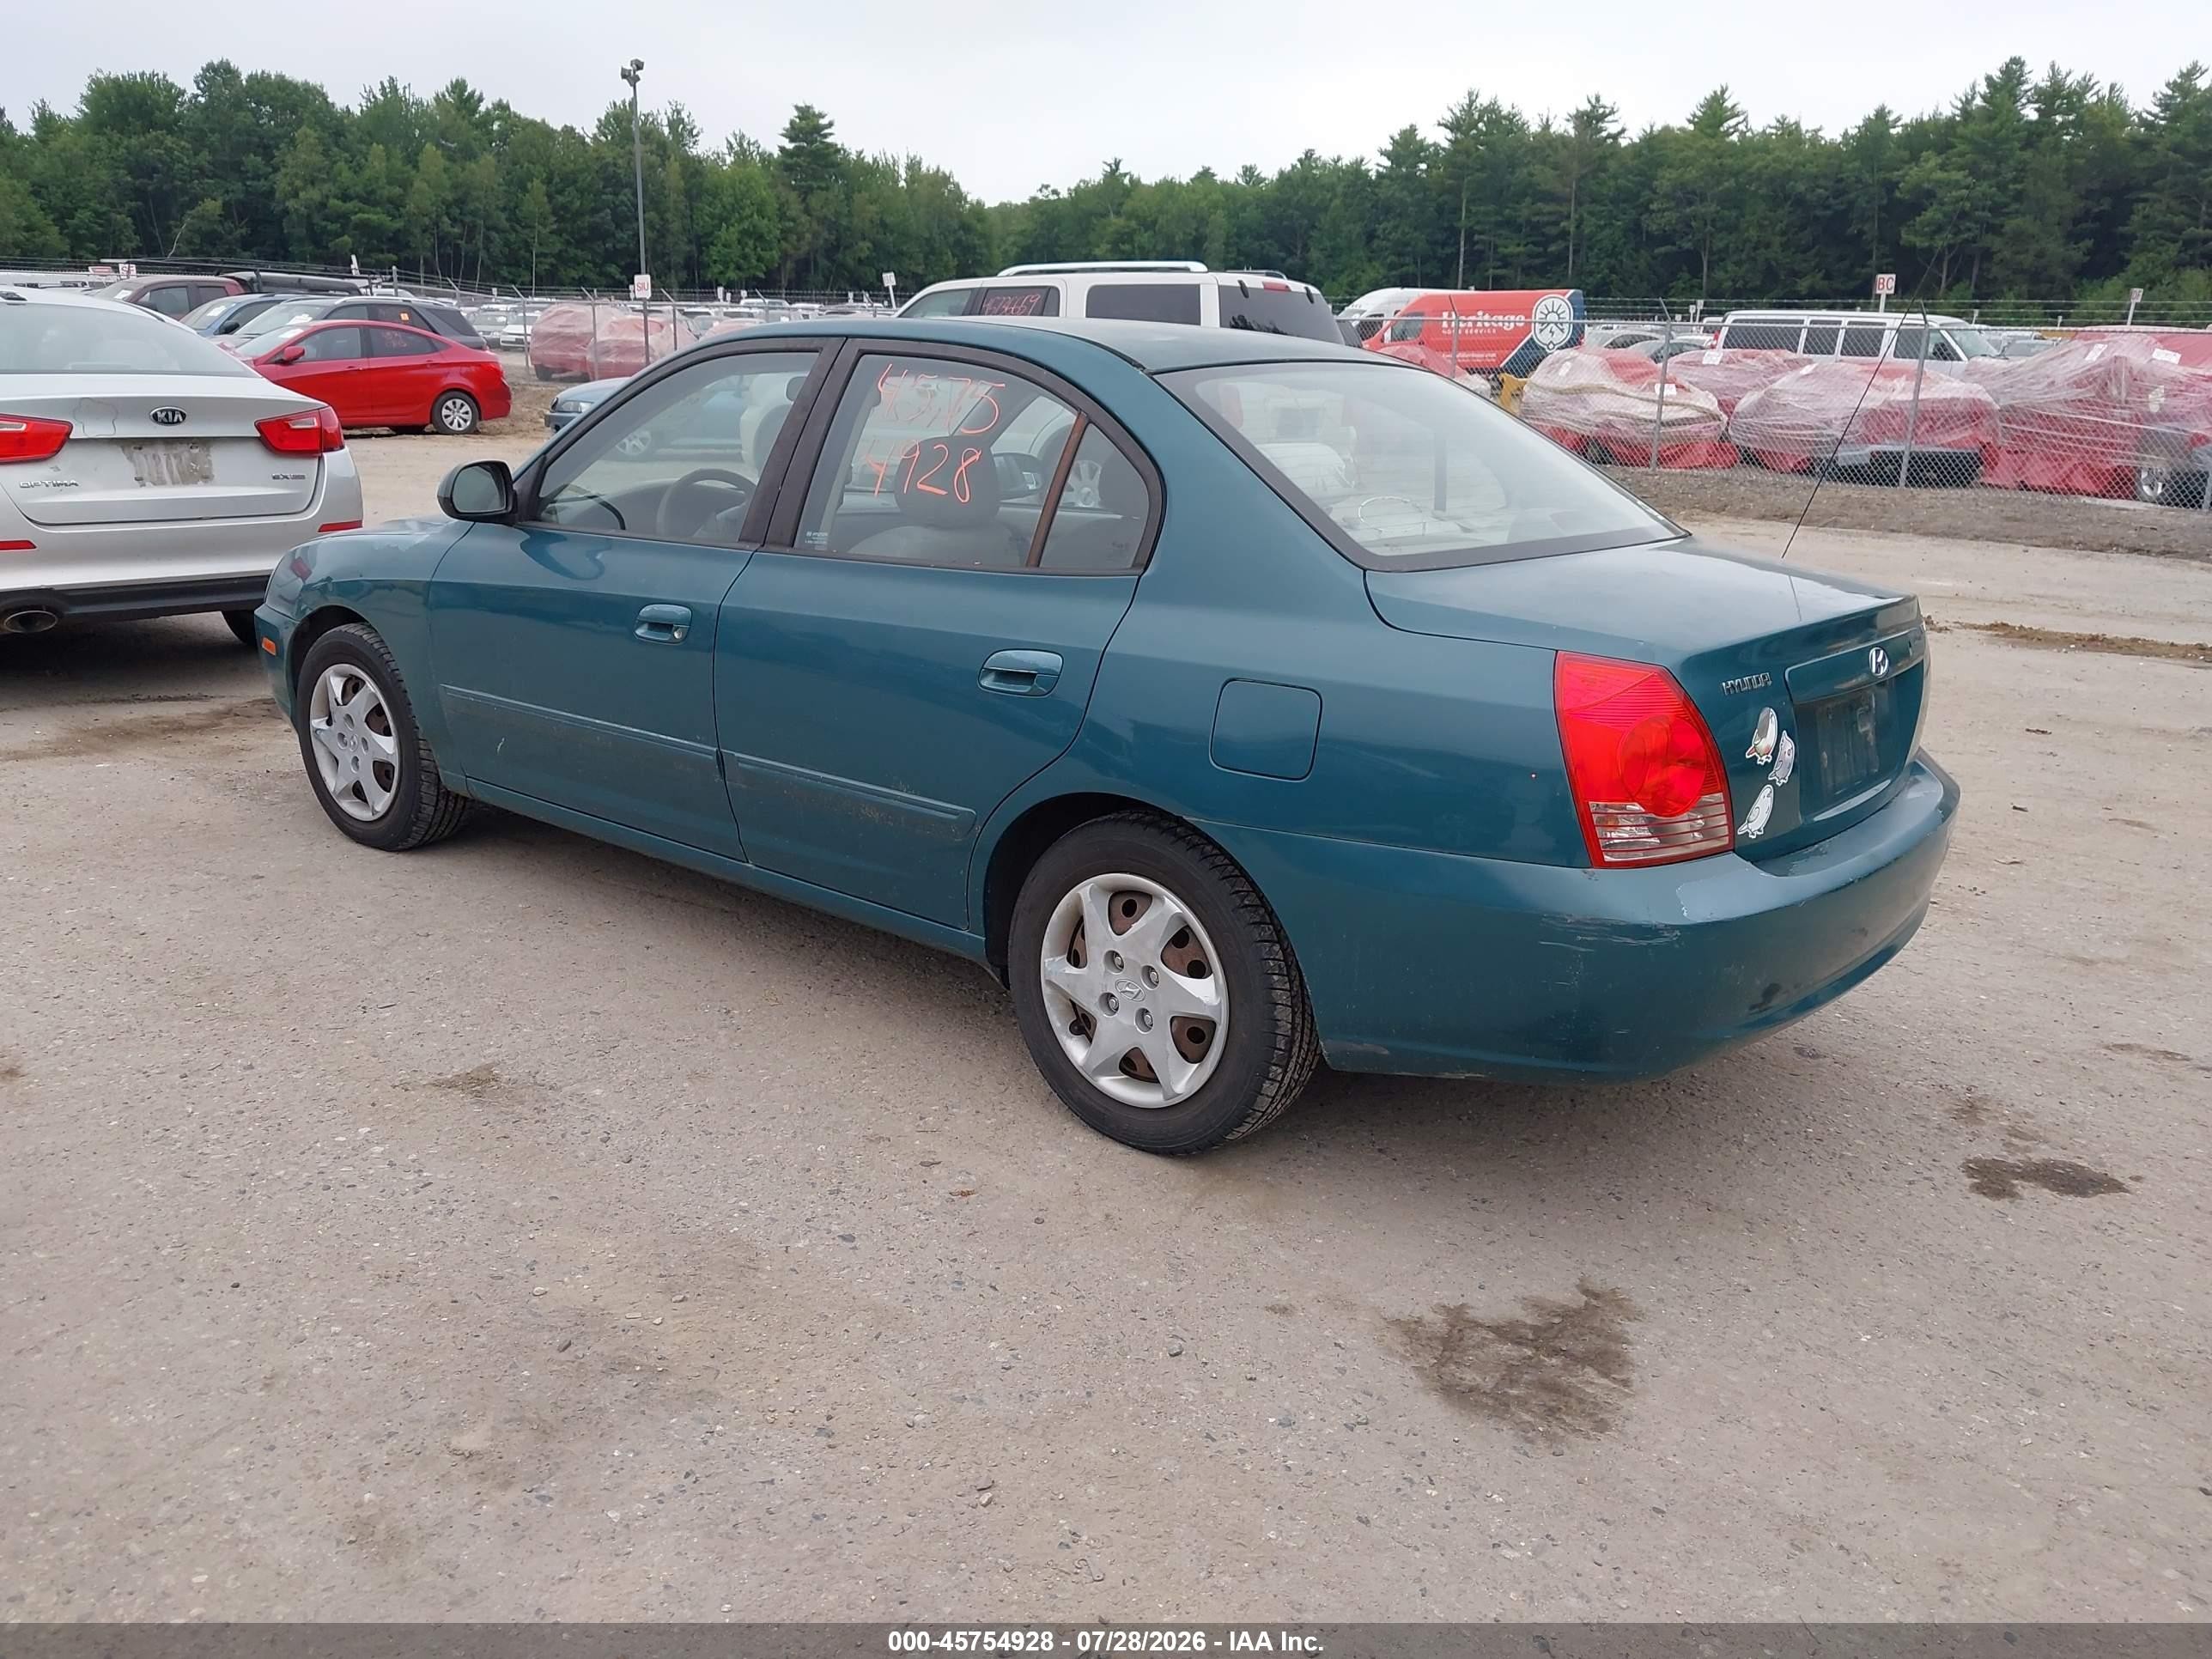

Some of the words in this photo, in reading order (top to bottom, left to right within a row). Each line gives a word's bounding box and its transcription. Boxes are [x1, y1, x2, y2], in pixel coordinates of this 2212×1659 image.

[636, 282, 648, 292] SIU
[1878, 276, 1894, 291] BC
[1442, 310, 1525, 331] Heritage
[156, 410, 183, 422] KIA
[865, 439, 982, 503] 4928
[20, 479, 79, 489] OPTIMA
[1722, 672, 1772, 696] HYUNDAI
